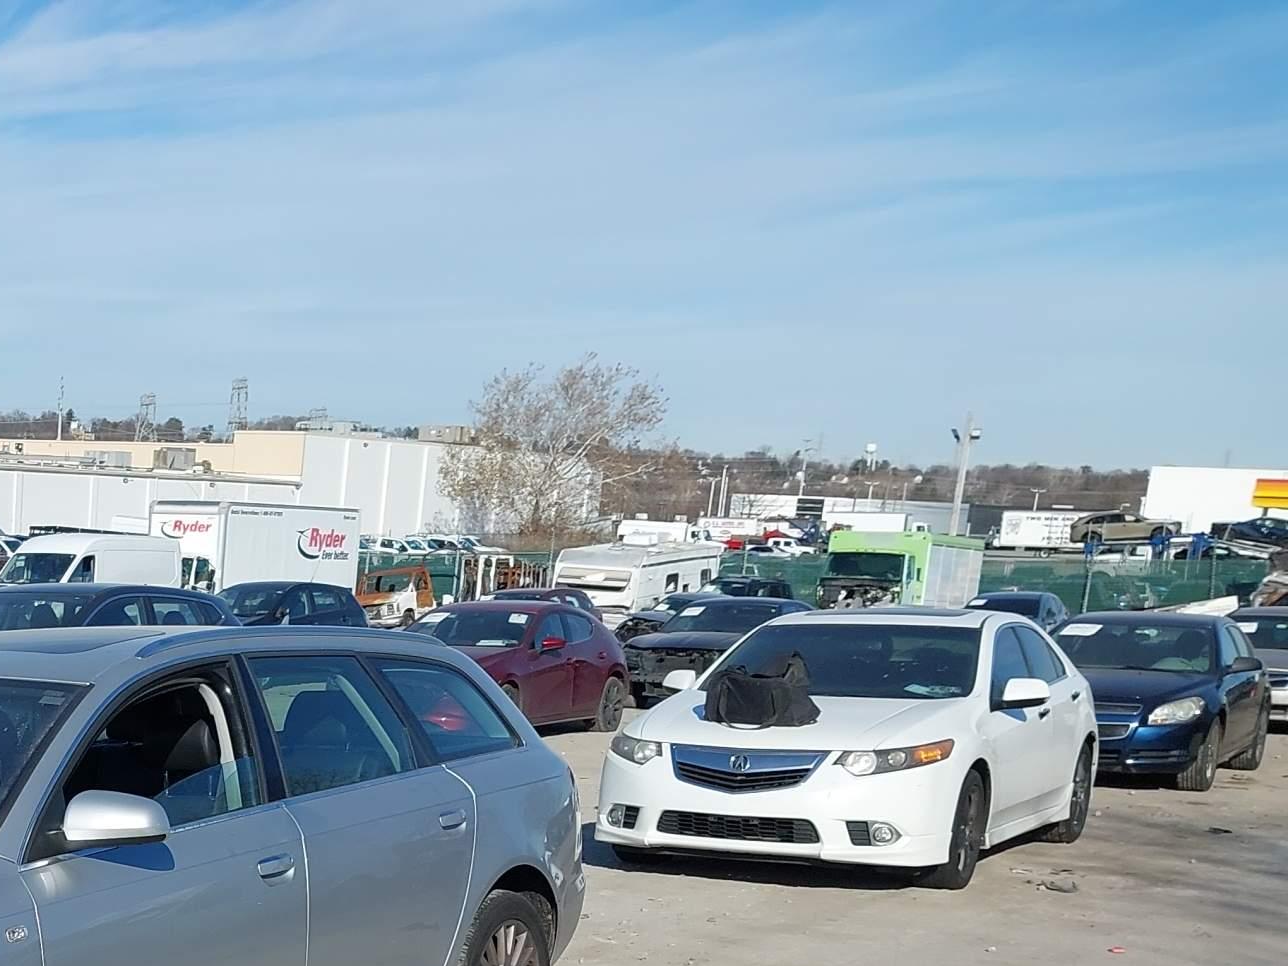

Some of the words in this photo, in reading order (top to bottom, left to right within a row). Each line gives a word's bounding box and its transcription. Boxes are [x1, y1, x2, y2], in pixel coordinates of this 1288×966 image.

[172, 519, 213, 535] Ryder
[308, 527, 347, 553] Ryder
[321, 550, 334, 560] Ever
